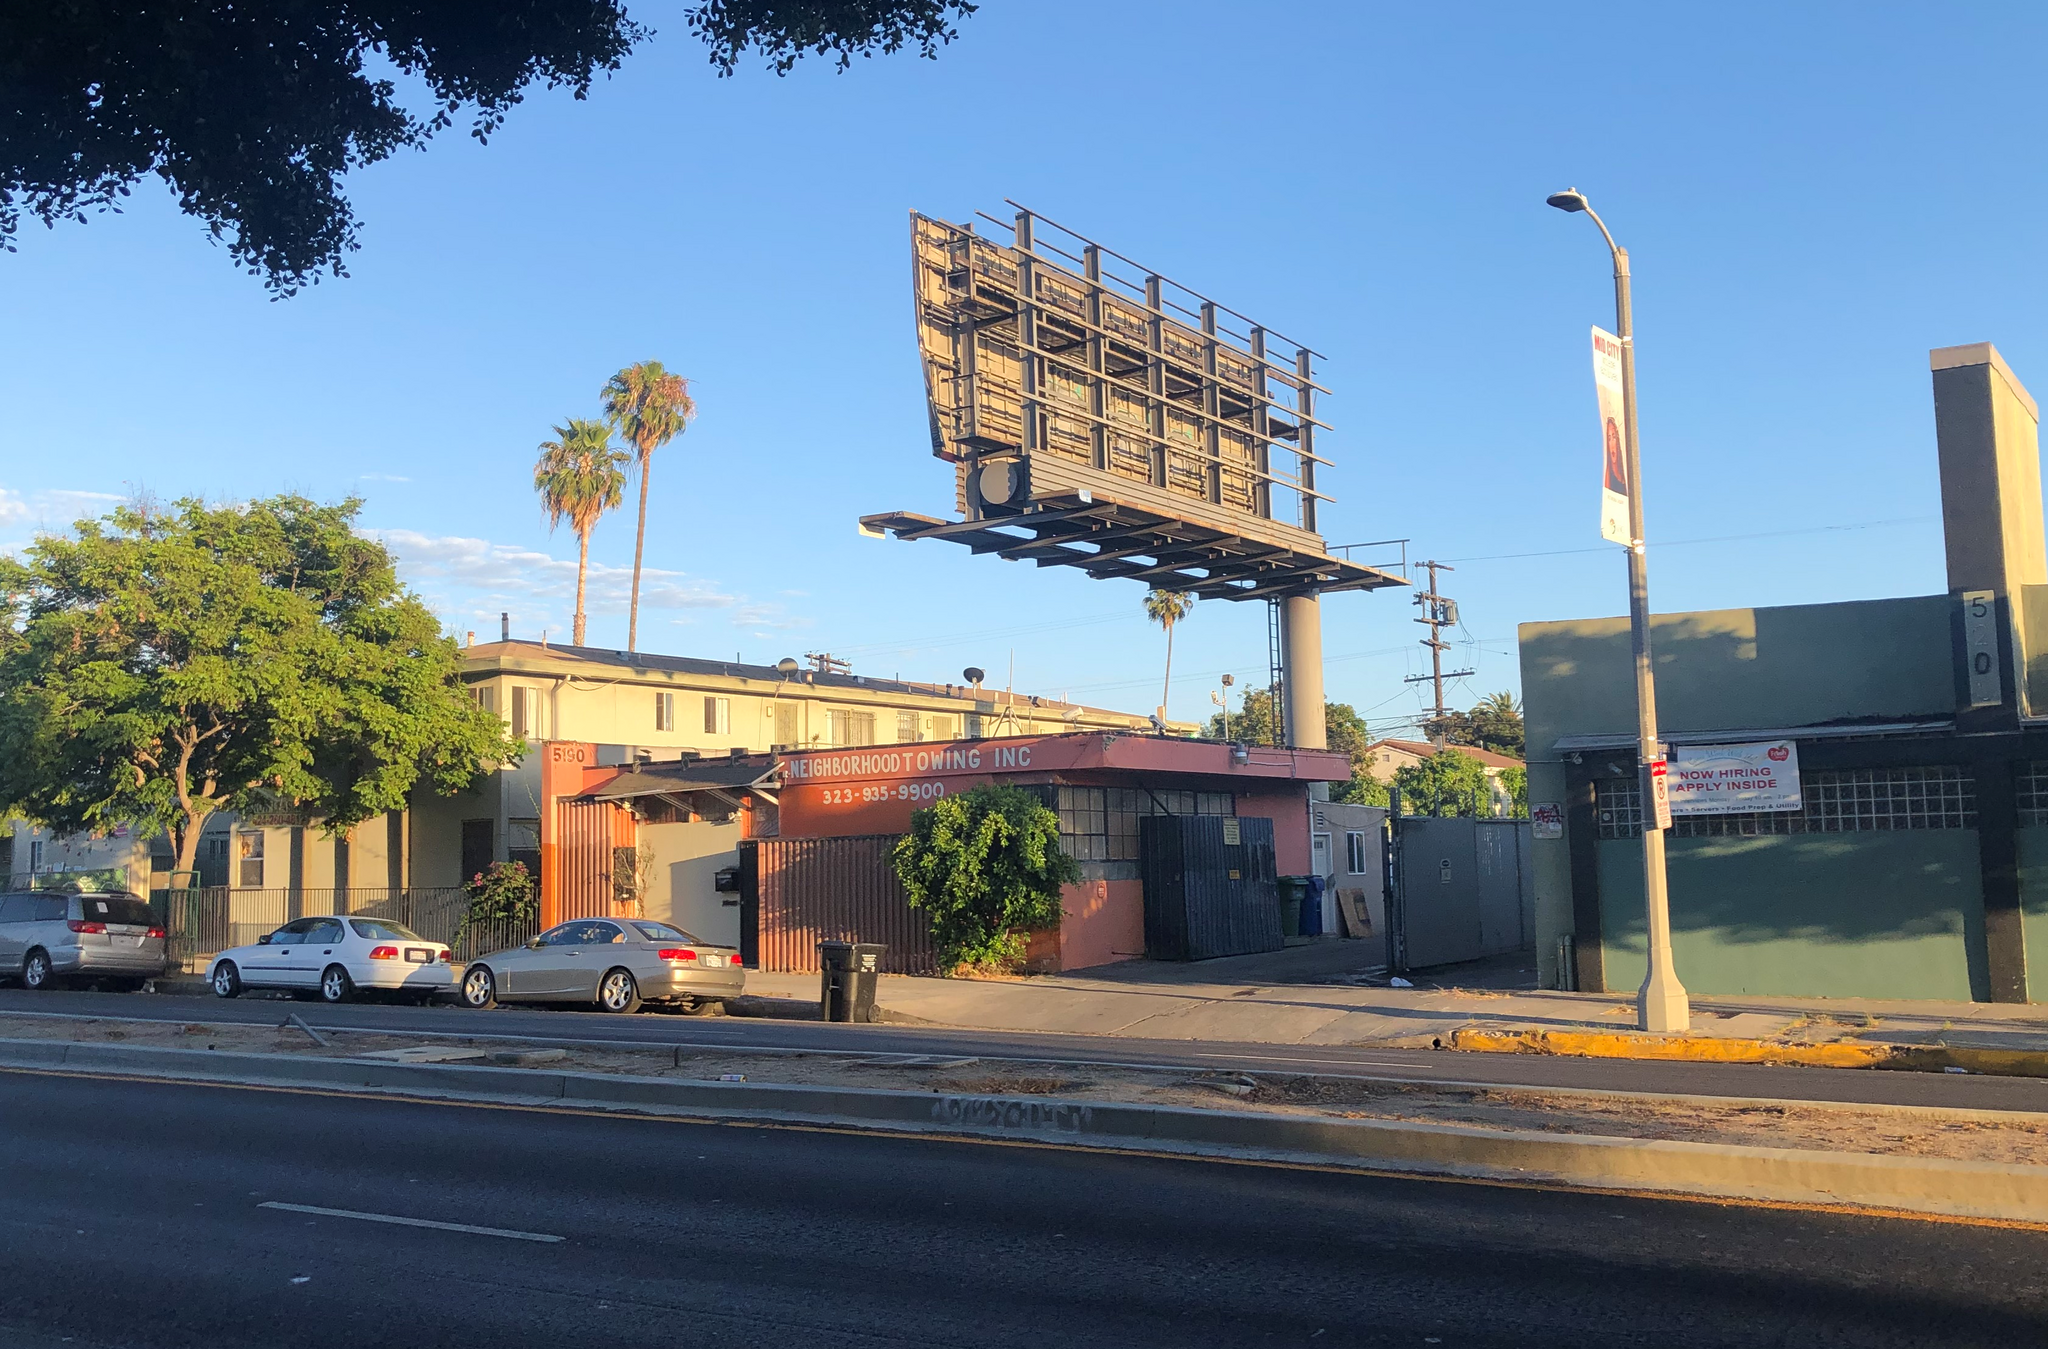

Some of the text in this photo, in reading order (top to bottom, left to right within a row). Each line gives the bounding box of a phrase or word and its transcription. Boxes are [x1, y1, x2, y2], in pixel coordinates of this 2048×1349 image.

[1594, 334, 1620, 361] MID CITY
[553, 747, 585, 763] 5190
[790, 746, 1031, 778] NEIGHBORHOOD TOWING INC
[1679, 767, 1772, 780] NOW HIRING
[822, 781, 945, 805] 323-935-9900
[1675, 779, 1777, 792] APPLY INSIDE
[1727, 804, 1746, 812] Food
[1748, 803, 1766, 811] Prep
